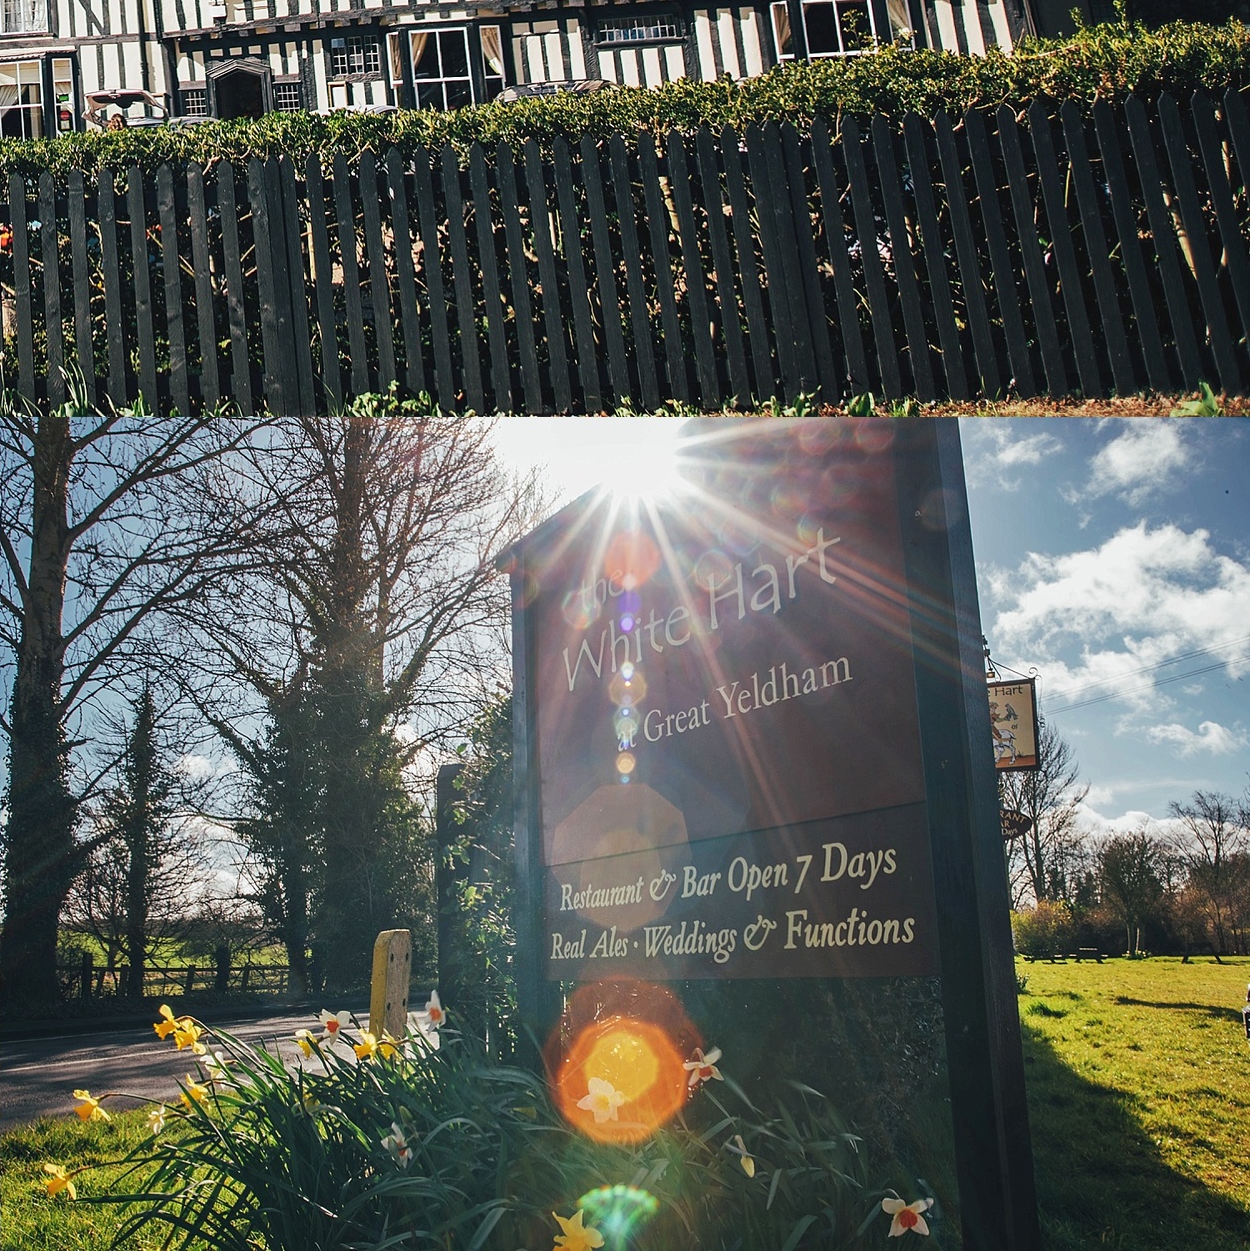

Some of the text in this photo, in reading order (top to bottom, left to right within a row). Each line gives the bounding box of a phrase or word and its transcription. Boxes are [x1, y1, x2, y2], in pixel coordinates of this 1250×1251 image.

[562, 526, 842, 693] White Hart
[577, 563, 625, 610] the
[616, 655, 854, 752] at Great Yeldham
[994, 685, 1023, 696] Hart
[559, 841, 897, 911] Restaurant & Bar Open 7 Days
[550, 907, 915, 964] Real Ales Weddings & Functions
